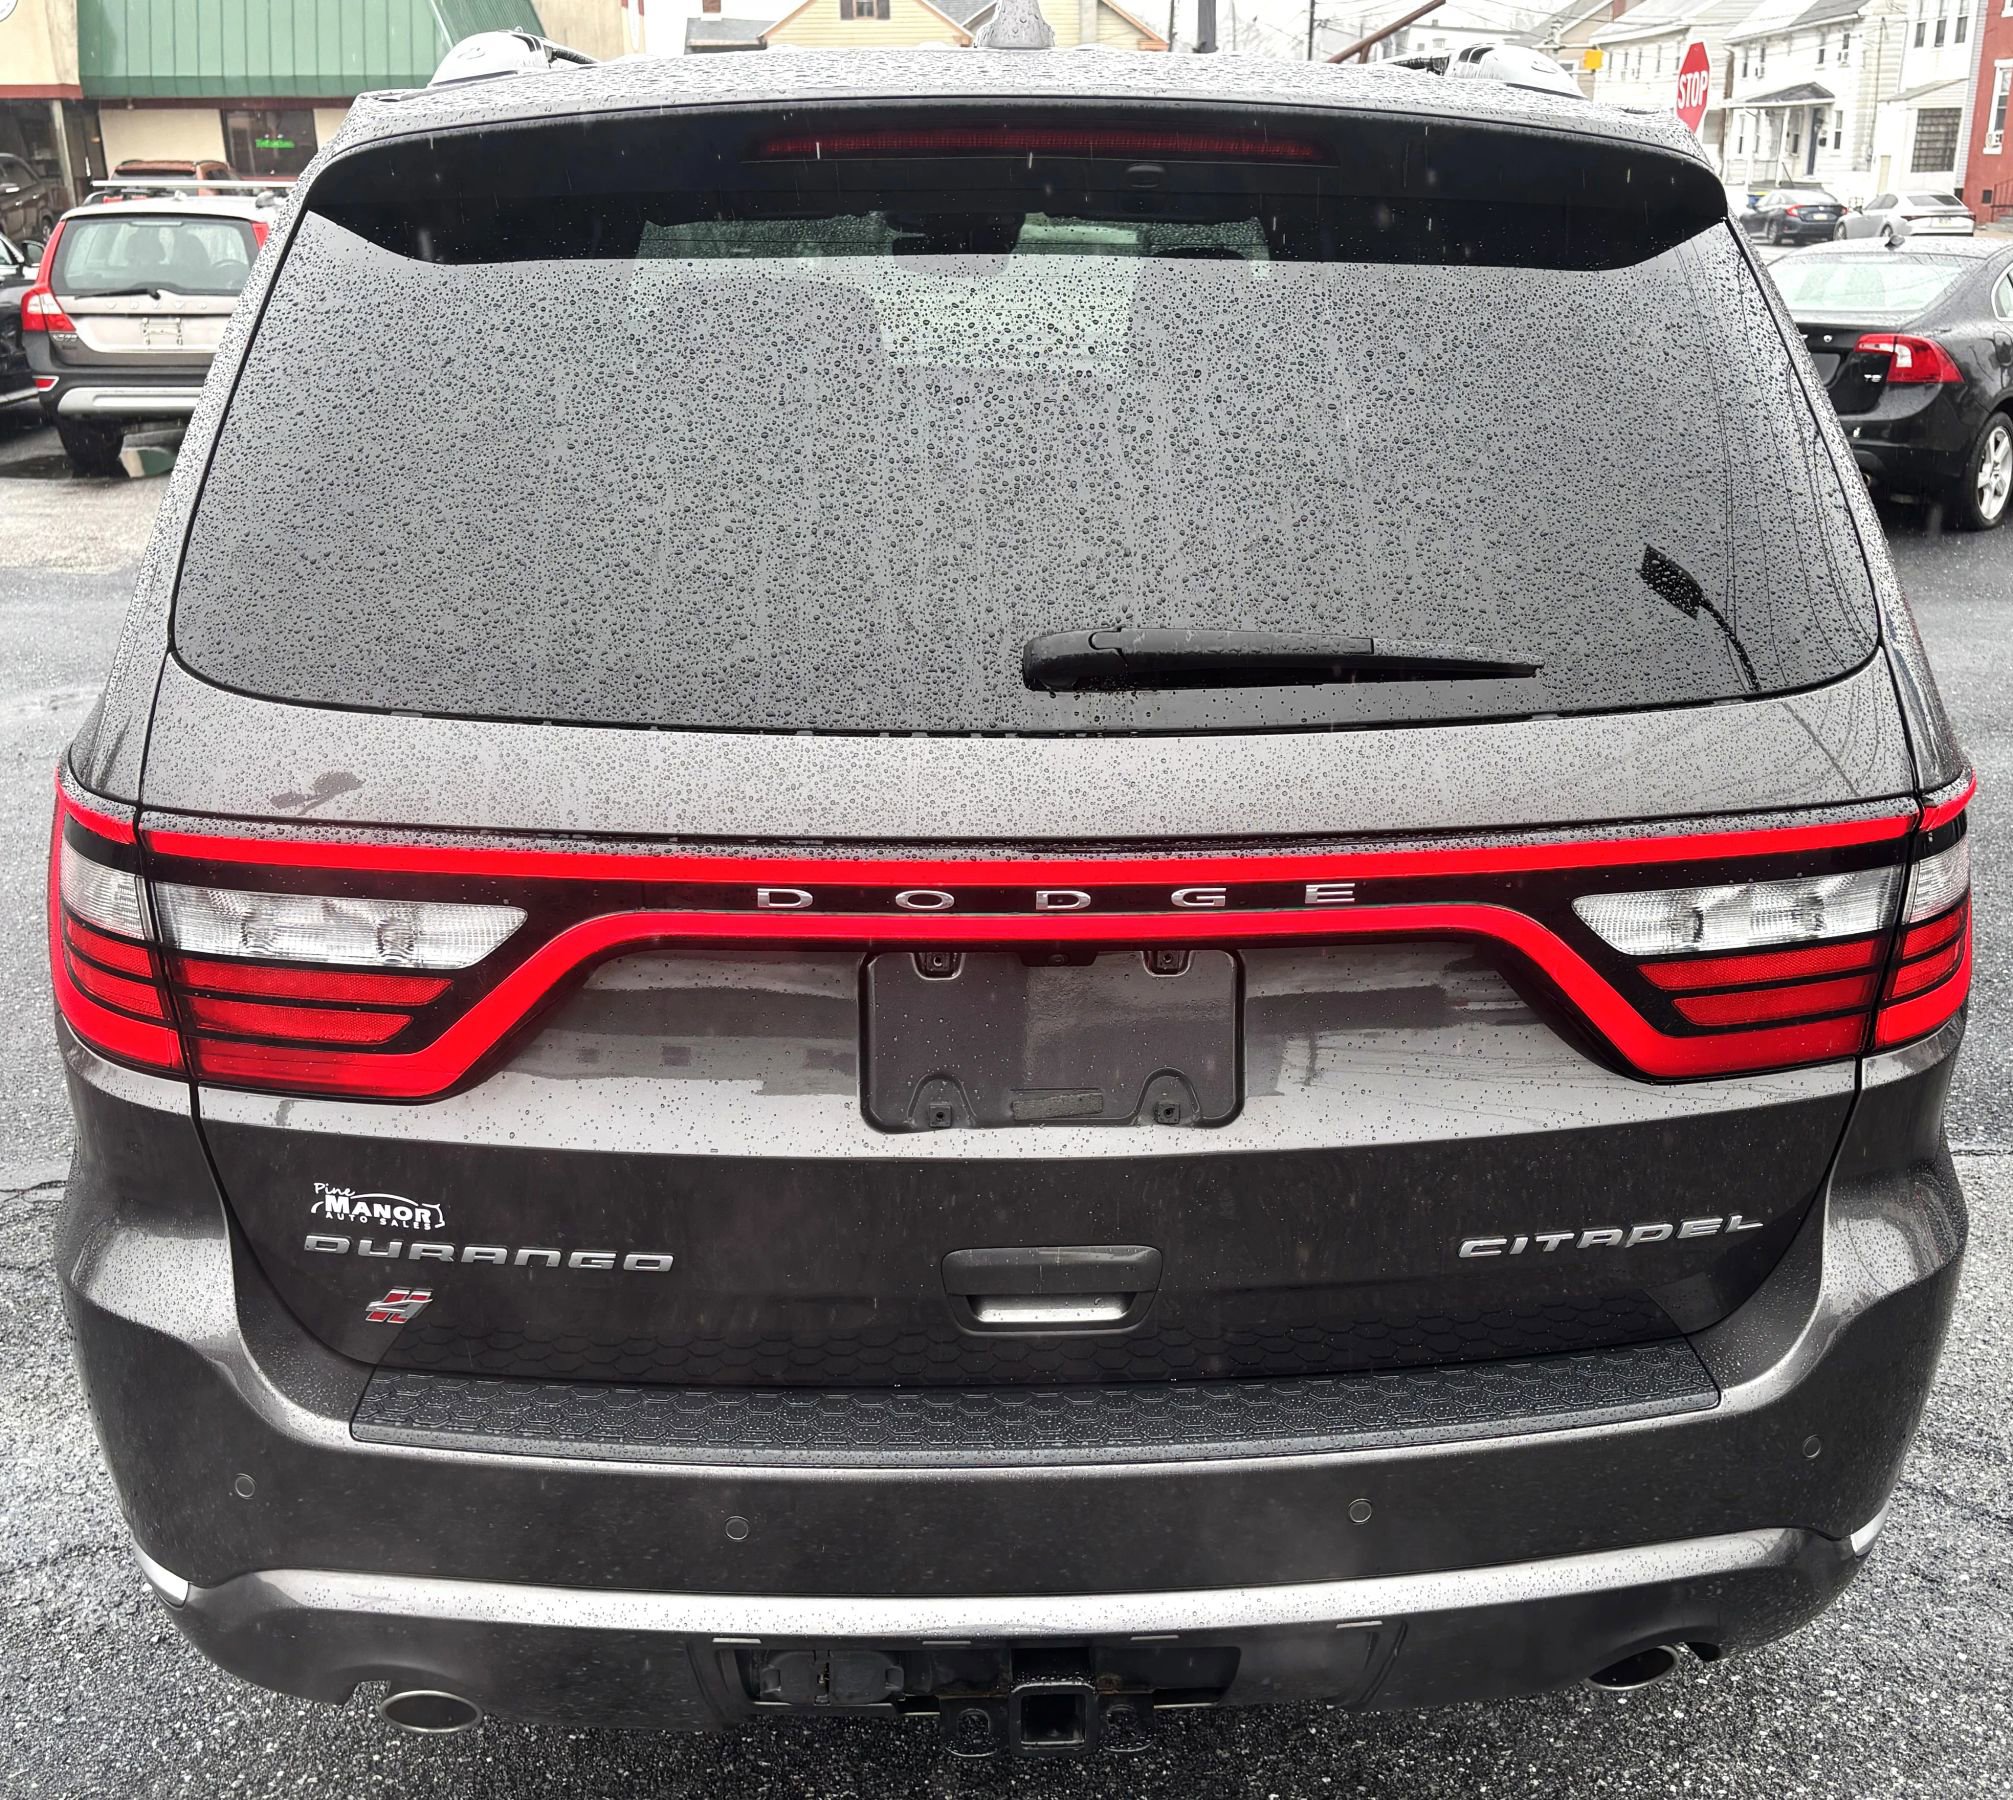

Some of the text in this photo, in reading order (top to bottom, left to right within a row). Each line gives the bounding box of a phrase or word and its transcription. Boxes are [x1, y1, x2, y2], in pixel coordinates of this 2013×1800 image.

[1678, 70, 1708, 109] STOP
[757, 883, 1355, 910] DODGE
[314, 1182, 355, 1197] Pine
[325, 1194, 432, 1223] MANOR
[325, 1211, 431, 1230] AUTO SALES
[1458, 1214, 1764, 1258] CITADEL
[304, 1233, 674, 1272] DURANGO
